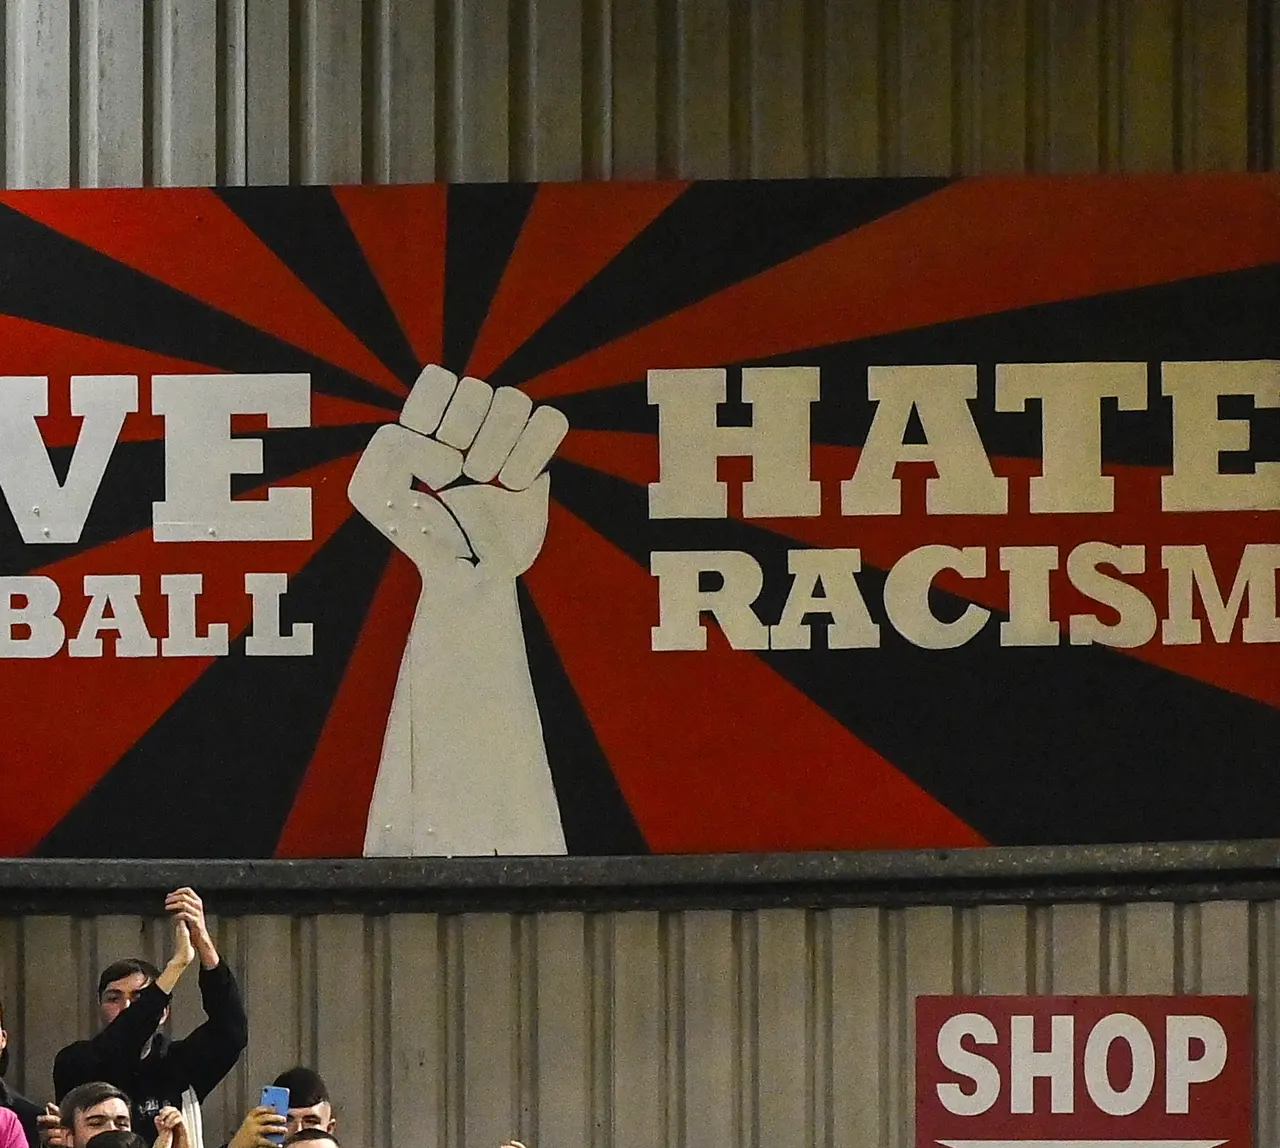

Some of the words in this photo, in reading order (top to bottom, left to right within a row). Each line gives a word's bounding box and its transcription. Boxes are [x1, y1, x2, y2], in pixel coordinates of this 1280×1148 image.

[647, 360, 1280, 519] HATE
[651, 541, 1280, 652] RACISM
[936, 1013, 1228, 1116] SHOP
